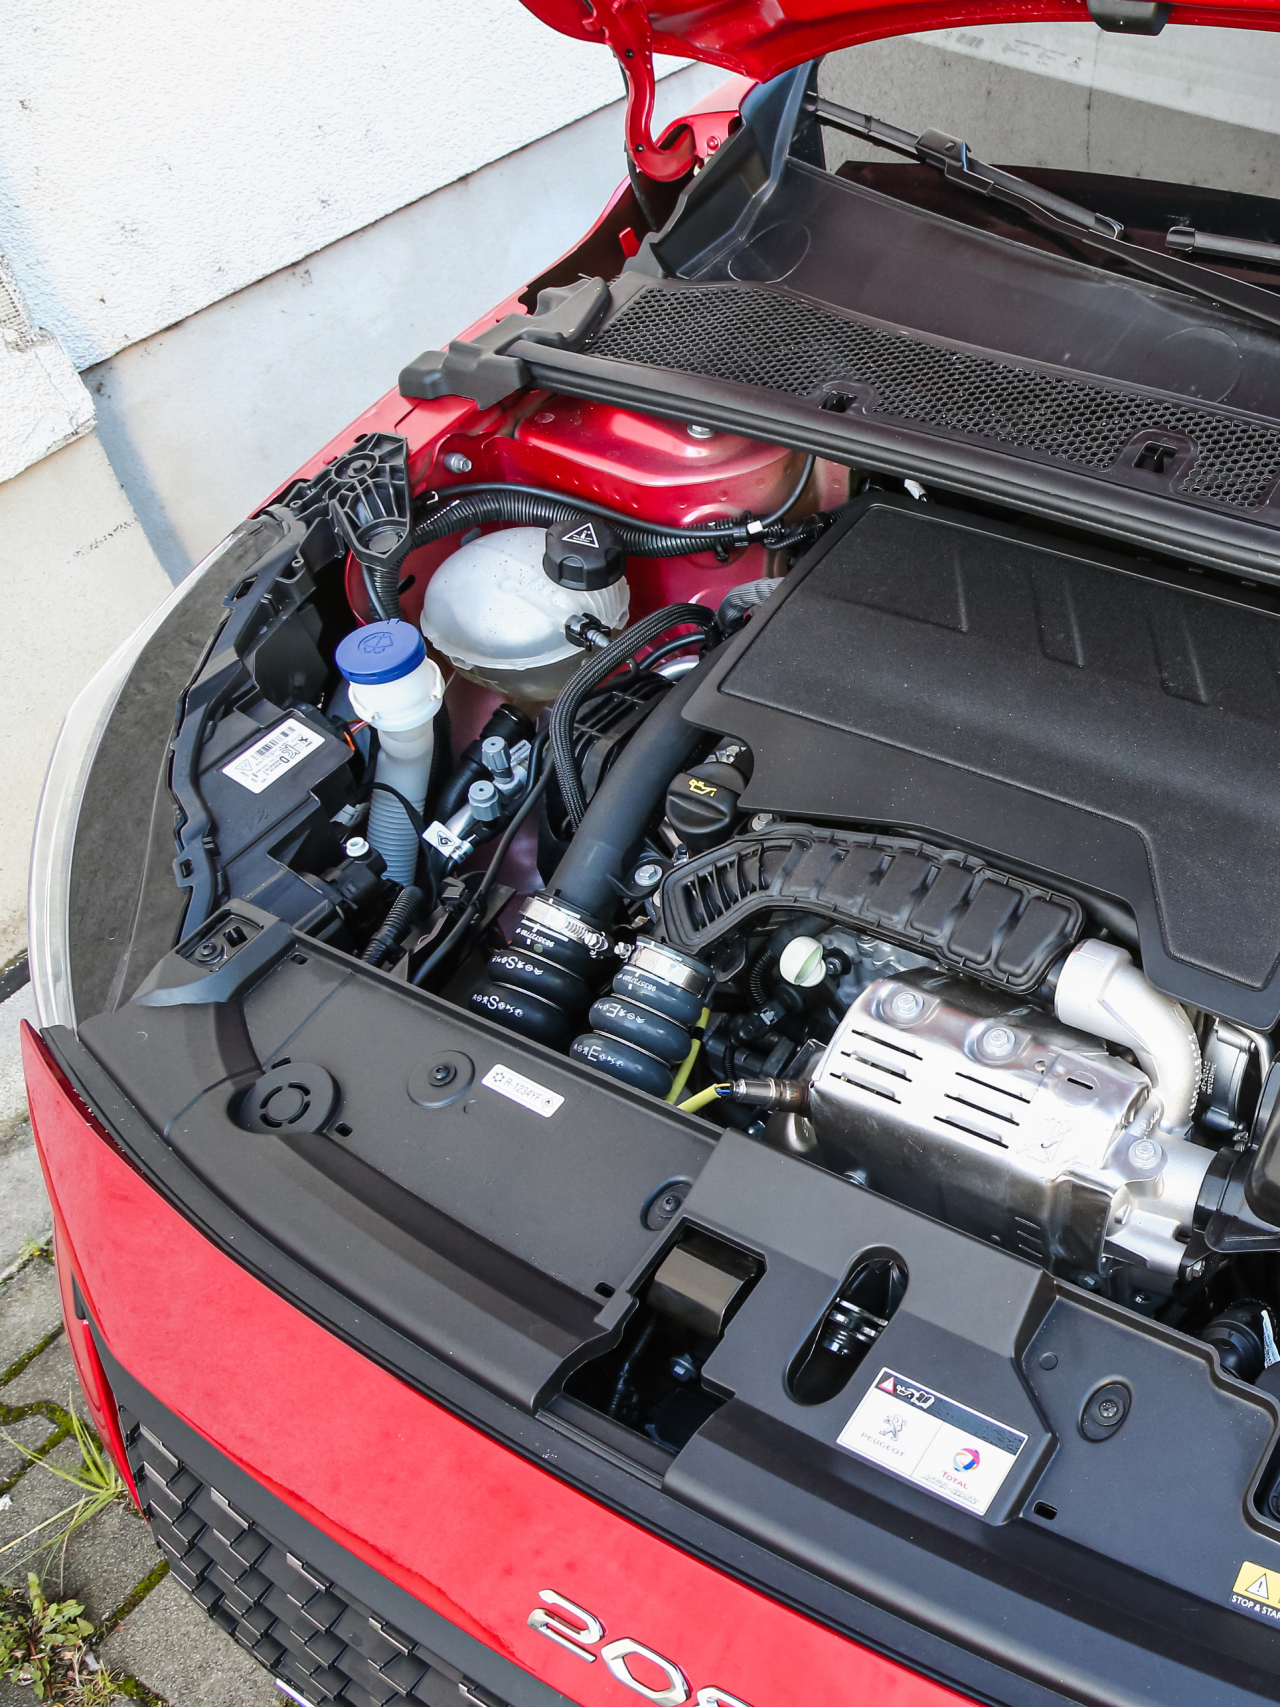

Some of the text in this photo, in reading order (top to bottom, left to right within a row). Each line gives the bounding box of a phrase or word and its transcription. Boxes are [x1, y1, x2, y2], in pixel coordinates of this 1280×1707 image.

[503, 1077, 543, 1102] R-1234YF
[860, 1432, 906, 1457] PEUGEOT
[1231, 1594, 1254, 1608] STOP
[1254, 1603, 1261, 1612] &
